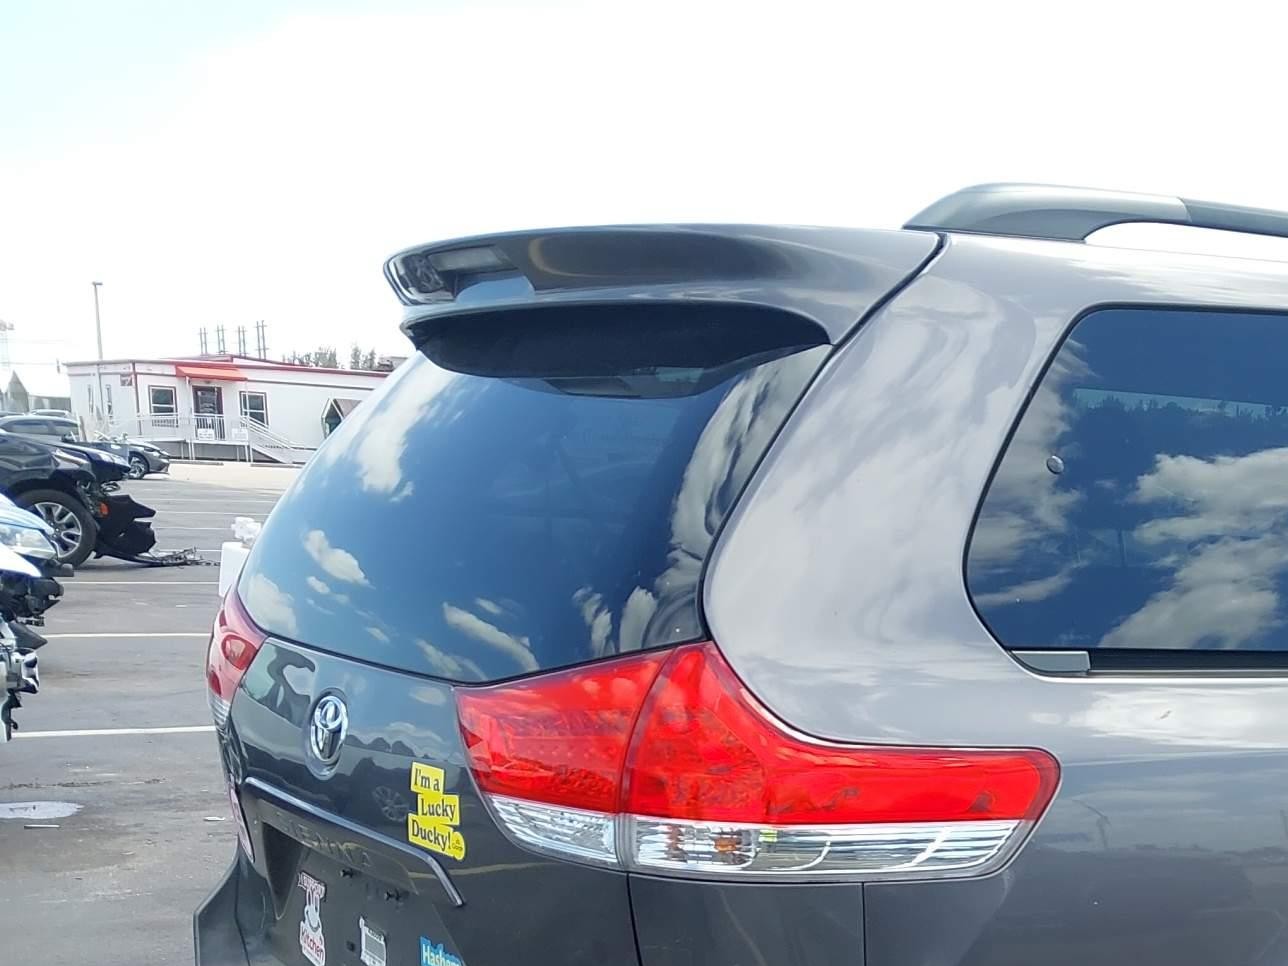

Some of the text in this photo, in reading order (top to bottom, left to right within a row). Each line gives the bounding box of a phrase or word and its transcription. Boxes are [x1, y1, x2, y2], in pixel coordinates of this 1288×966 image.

[415, 768, 440, 792] I'm a
[421, 799, 456, 822] Lucky
[412, 818, 451, 852] Ducky!
